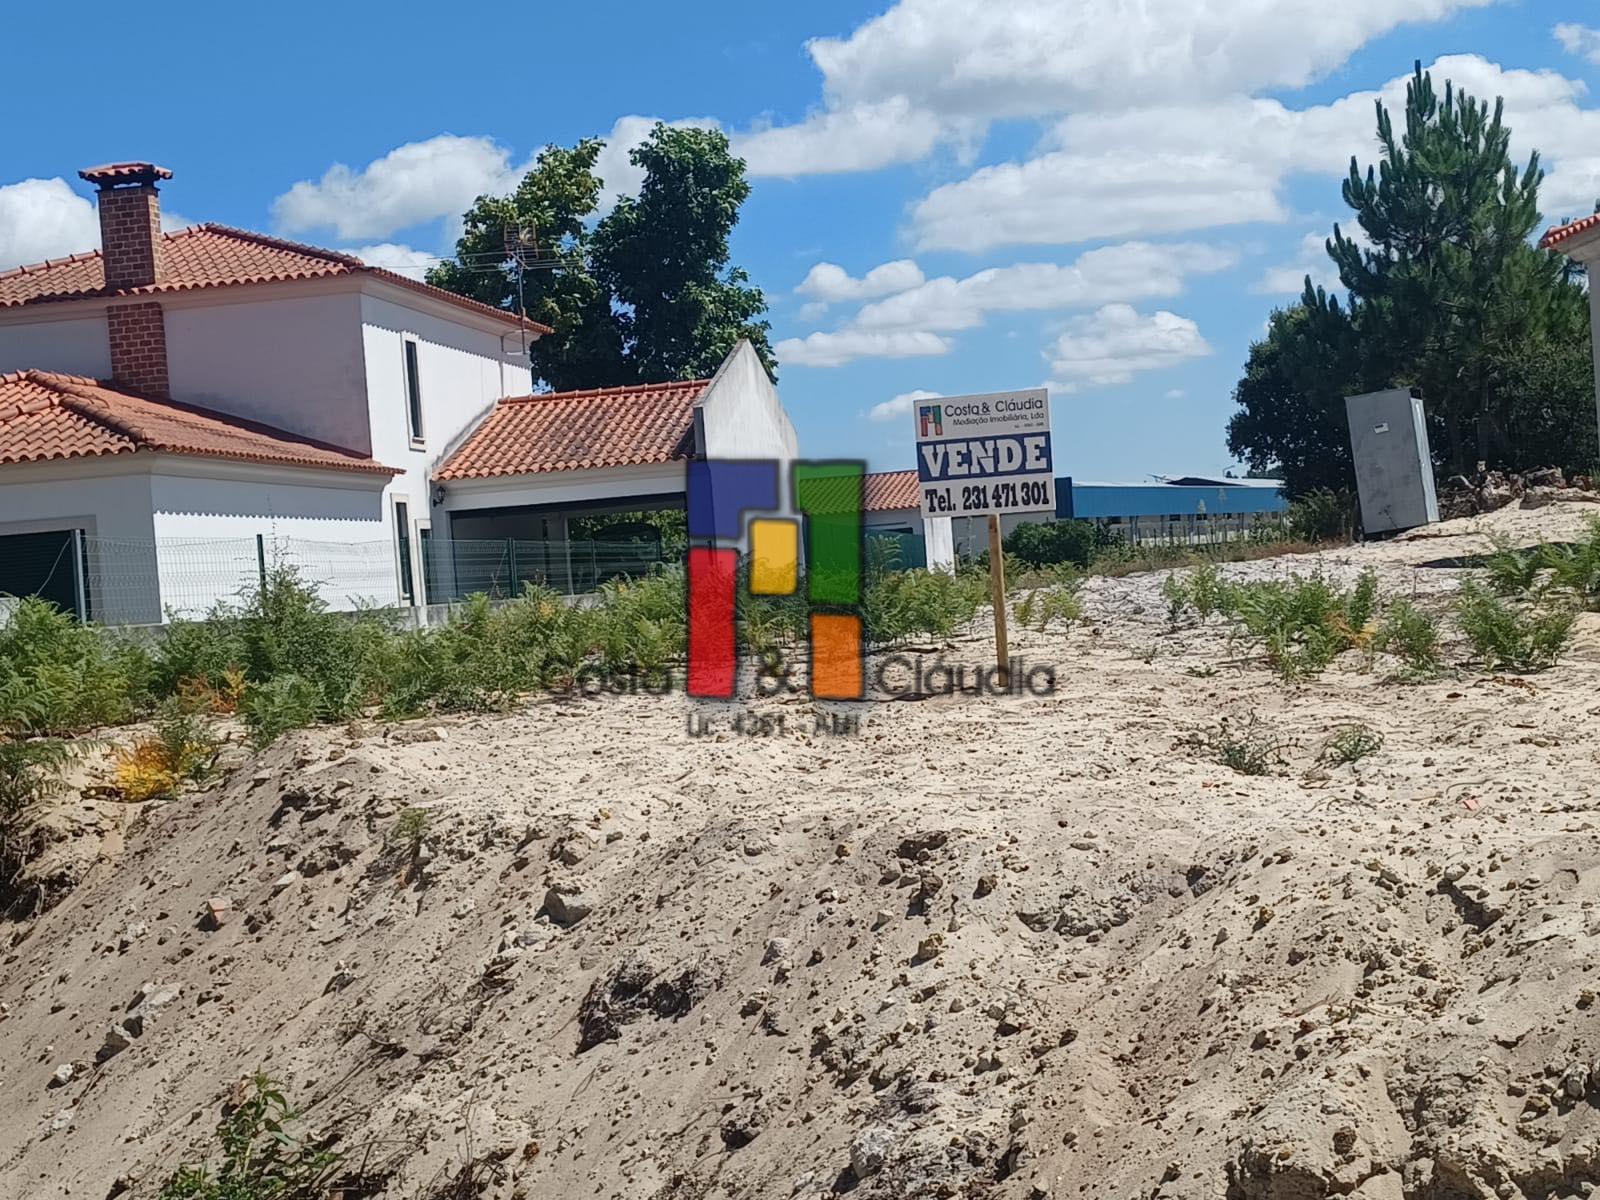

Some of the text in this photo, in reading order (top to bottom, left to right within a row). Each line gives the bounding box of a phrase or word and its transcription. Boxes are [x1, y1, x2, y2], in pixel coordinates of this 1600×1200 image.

[944, 398, 1043, 417] Costa & Cláudia
[953, 415, 988, 425] Mediação
[922, 436, 1047, 477] VENDE
[925, 481, 1049, 512] Tel. 231 471 301
